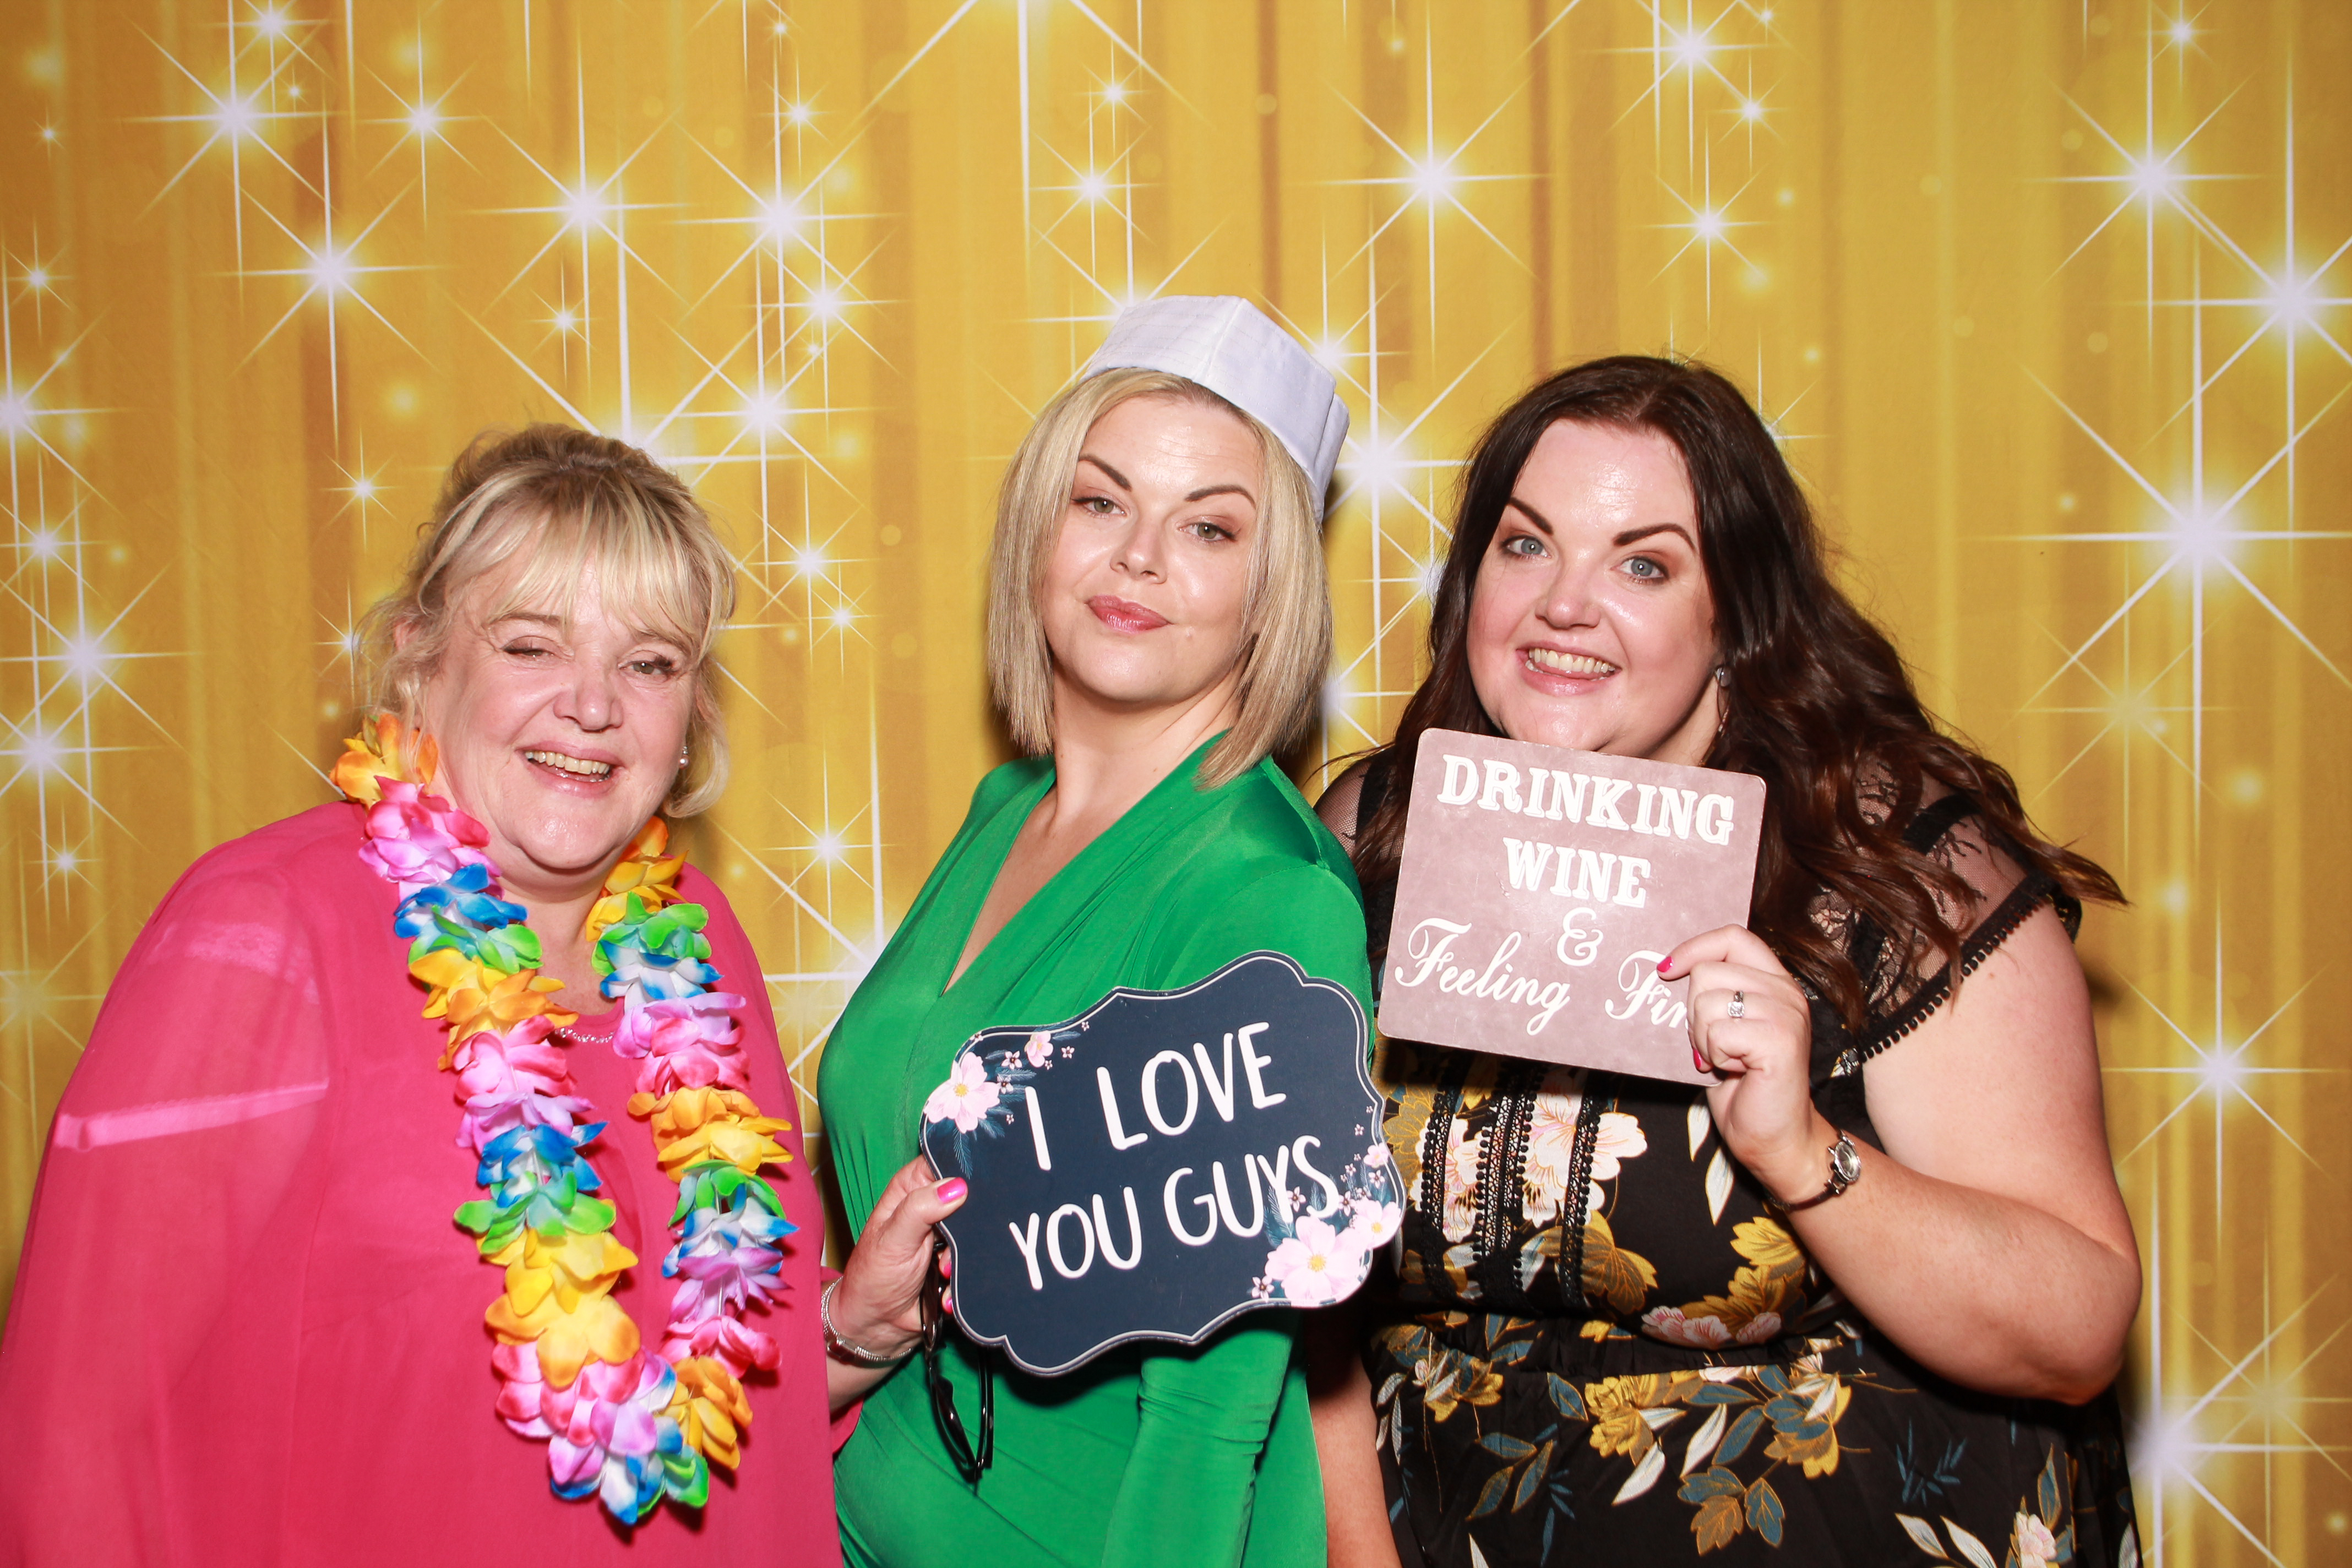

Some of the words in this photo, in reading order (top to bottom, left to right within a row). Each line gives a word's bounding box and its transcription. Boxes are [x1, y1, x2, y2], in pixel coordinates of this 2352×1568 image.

[1437, 754, 1734, 846] DRINKING
[1503, 837, 1651, 908] WINE
[1395, 917, 1570, 1036] Feeling
[1604, 950, 1690, 1030] Fin
[1557, 907, 1603, 966] &
[1025, 1086, 1052, 1170] I
[1096, 1021, 1287, 1150] LOVE
[1009, 1186, 1142, 1291] YOU
[1163, 1135, 1340, 1246] GUYS
